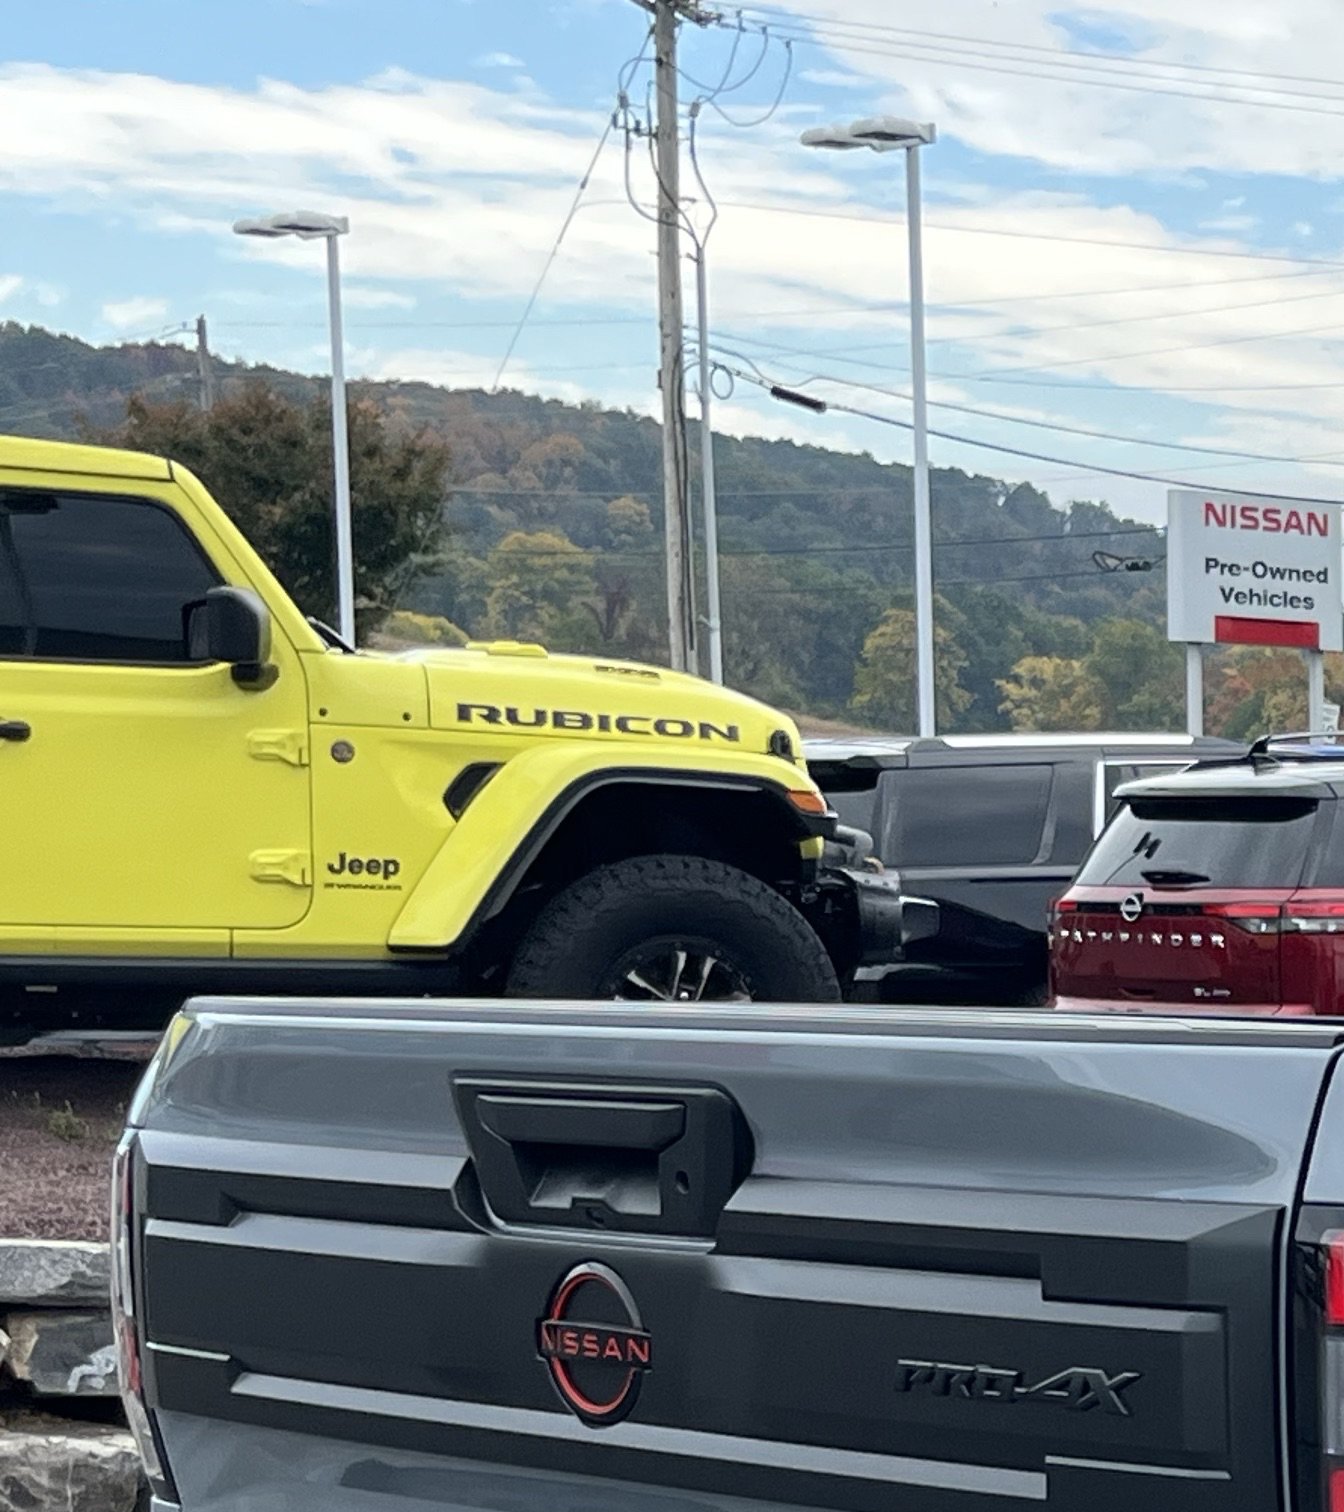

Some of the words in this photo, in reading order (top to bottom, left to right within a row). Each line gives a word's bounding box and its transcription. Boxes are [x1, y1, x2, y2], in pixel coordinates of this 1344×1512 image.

[1204, 502, 1329, 537] NISSAN
[1204, 556, 1329, 585] Pre-Owned
[1219, 585, 1315, 611] Vehicles
[456, 703, 740, 743] RUBICON
[326, 851, 400, 881] Jeep
[541, 1325, 651, 1363] NISSAN
[894, 1358, 1143, 1416] PRO-4X
